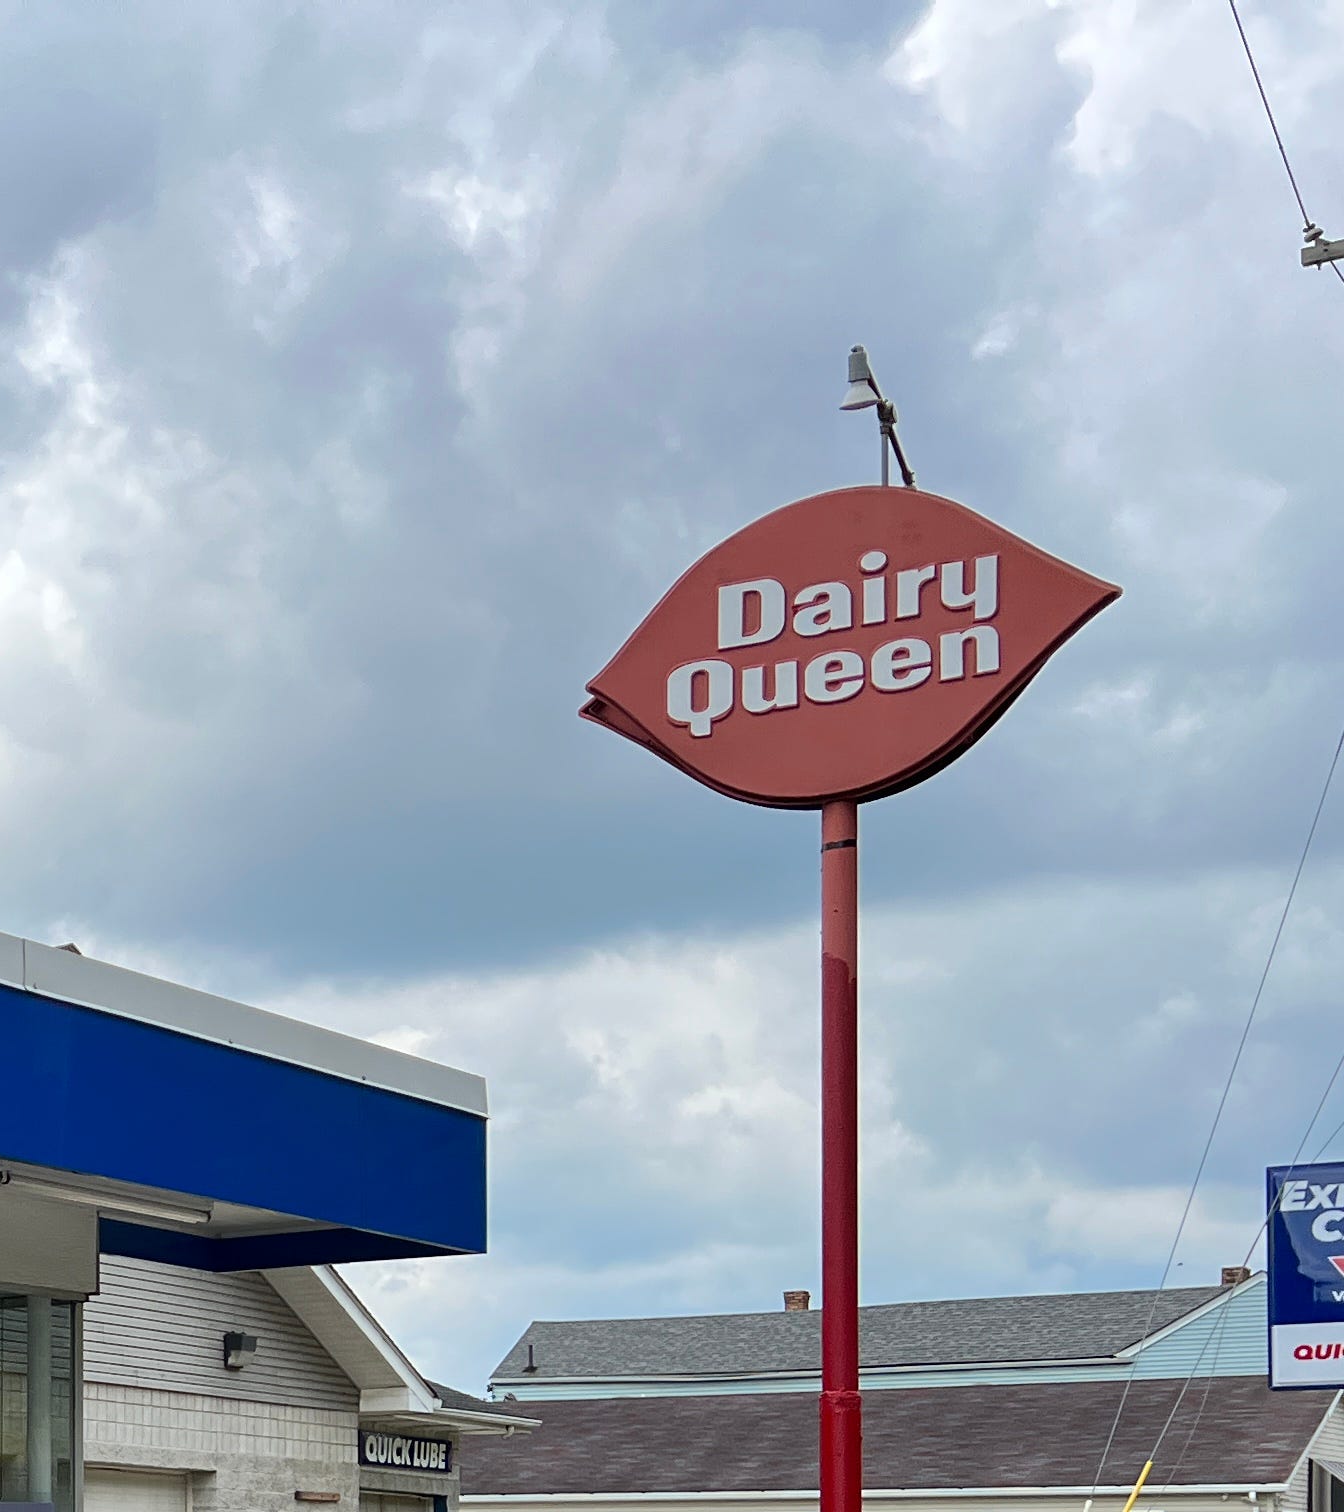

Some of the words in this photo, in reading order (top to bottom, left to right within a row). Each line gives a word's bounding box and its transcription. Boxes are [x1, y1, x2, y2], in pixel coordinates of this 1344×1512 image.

[717, 548, 1000, 652] Dairy
[665, 622, 1001, 738] Queen
[1279, 1180, 1344, 1211] EX
[1311, 1210, 1344, 1243] C
[1293, 1343, 1344, 1361] QUI
[365, 1434, 412, 1466] QUICK
[413, 1440, 447, 1470] LUBE
